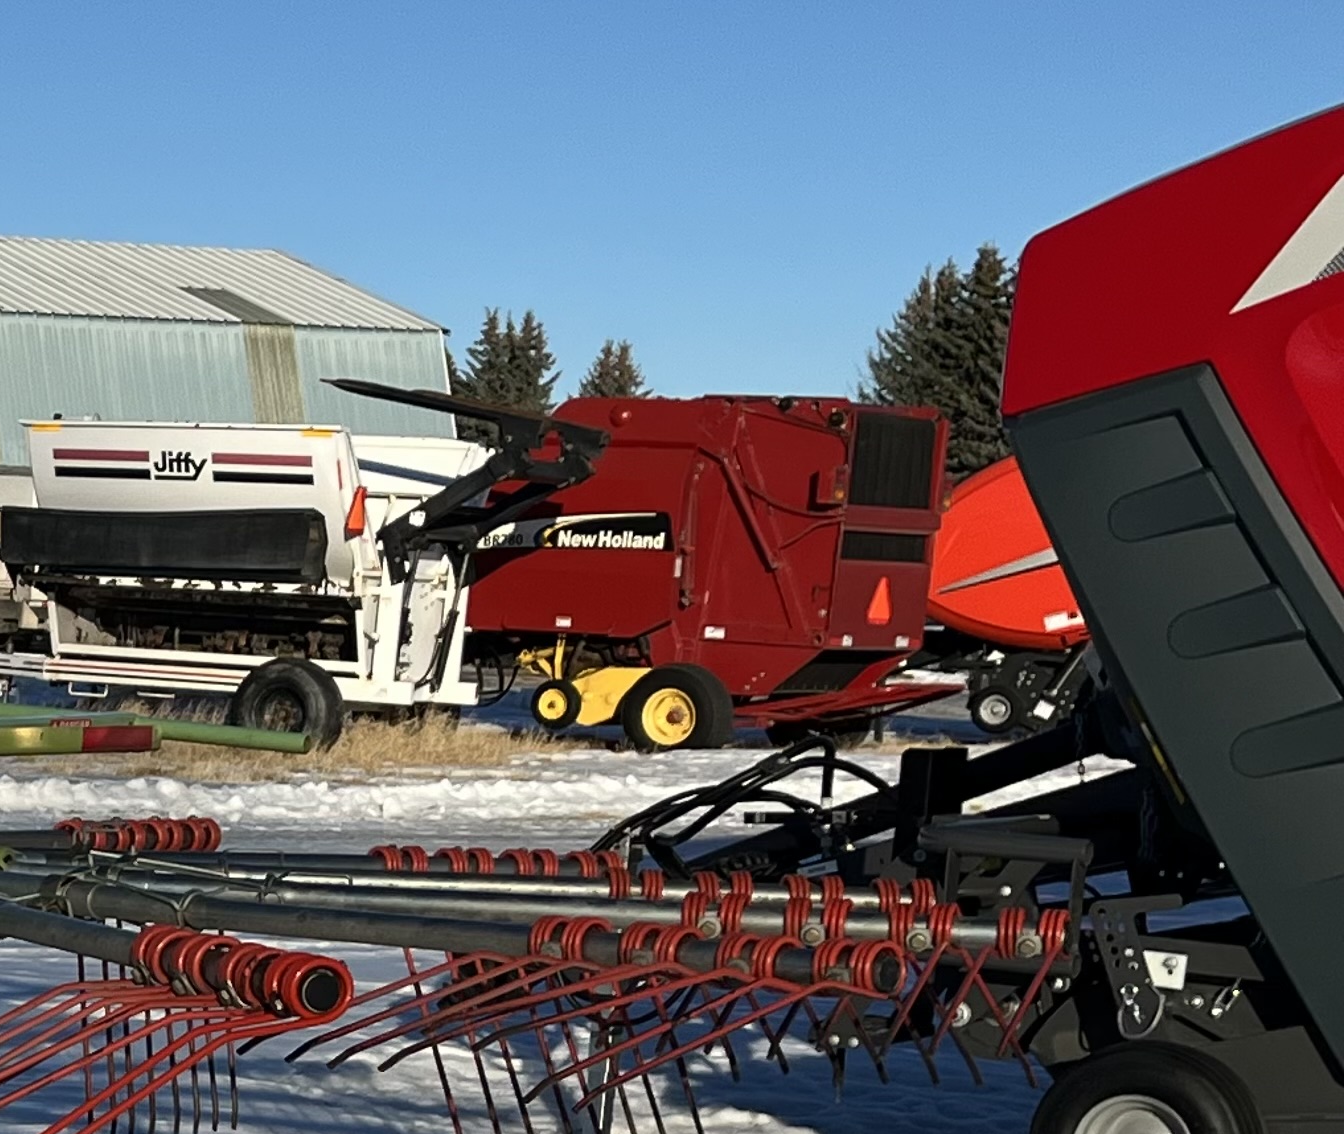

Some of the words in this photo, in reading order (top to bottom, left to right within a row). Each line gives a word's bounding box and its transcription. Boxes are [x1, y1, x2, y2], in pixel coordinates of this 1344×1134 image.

[153, 450, 208, 481] Jiffy
[556, 530, 598, 548] New
[598, 530, 666, 550] Holland
